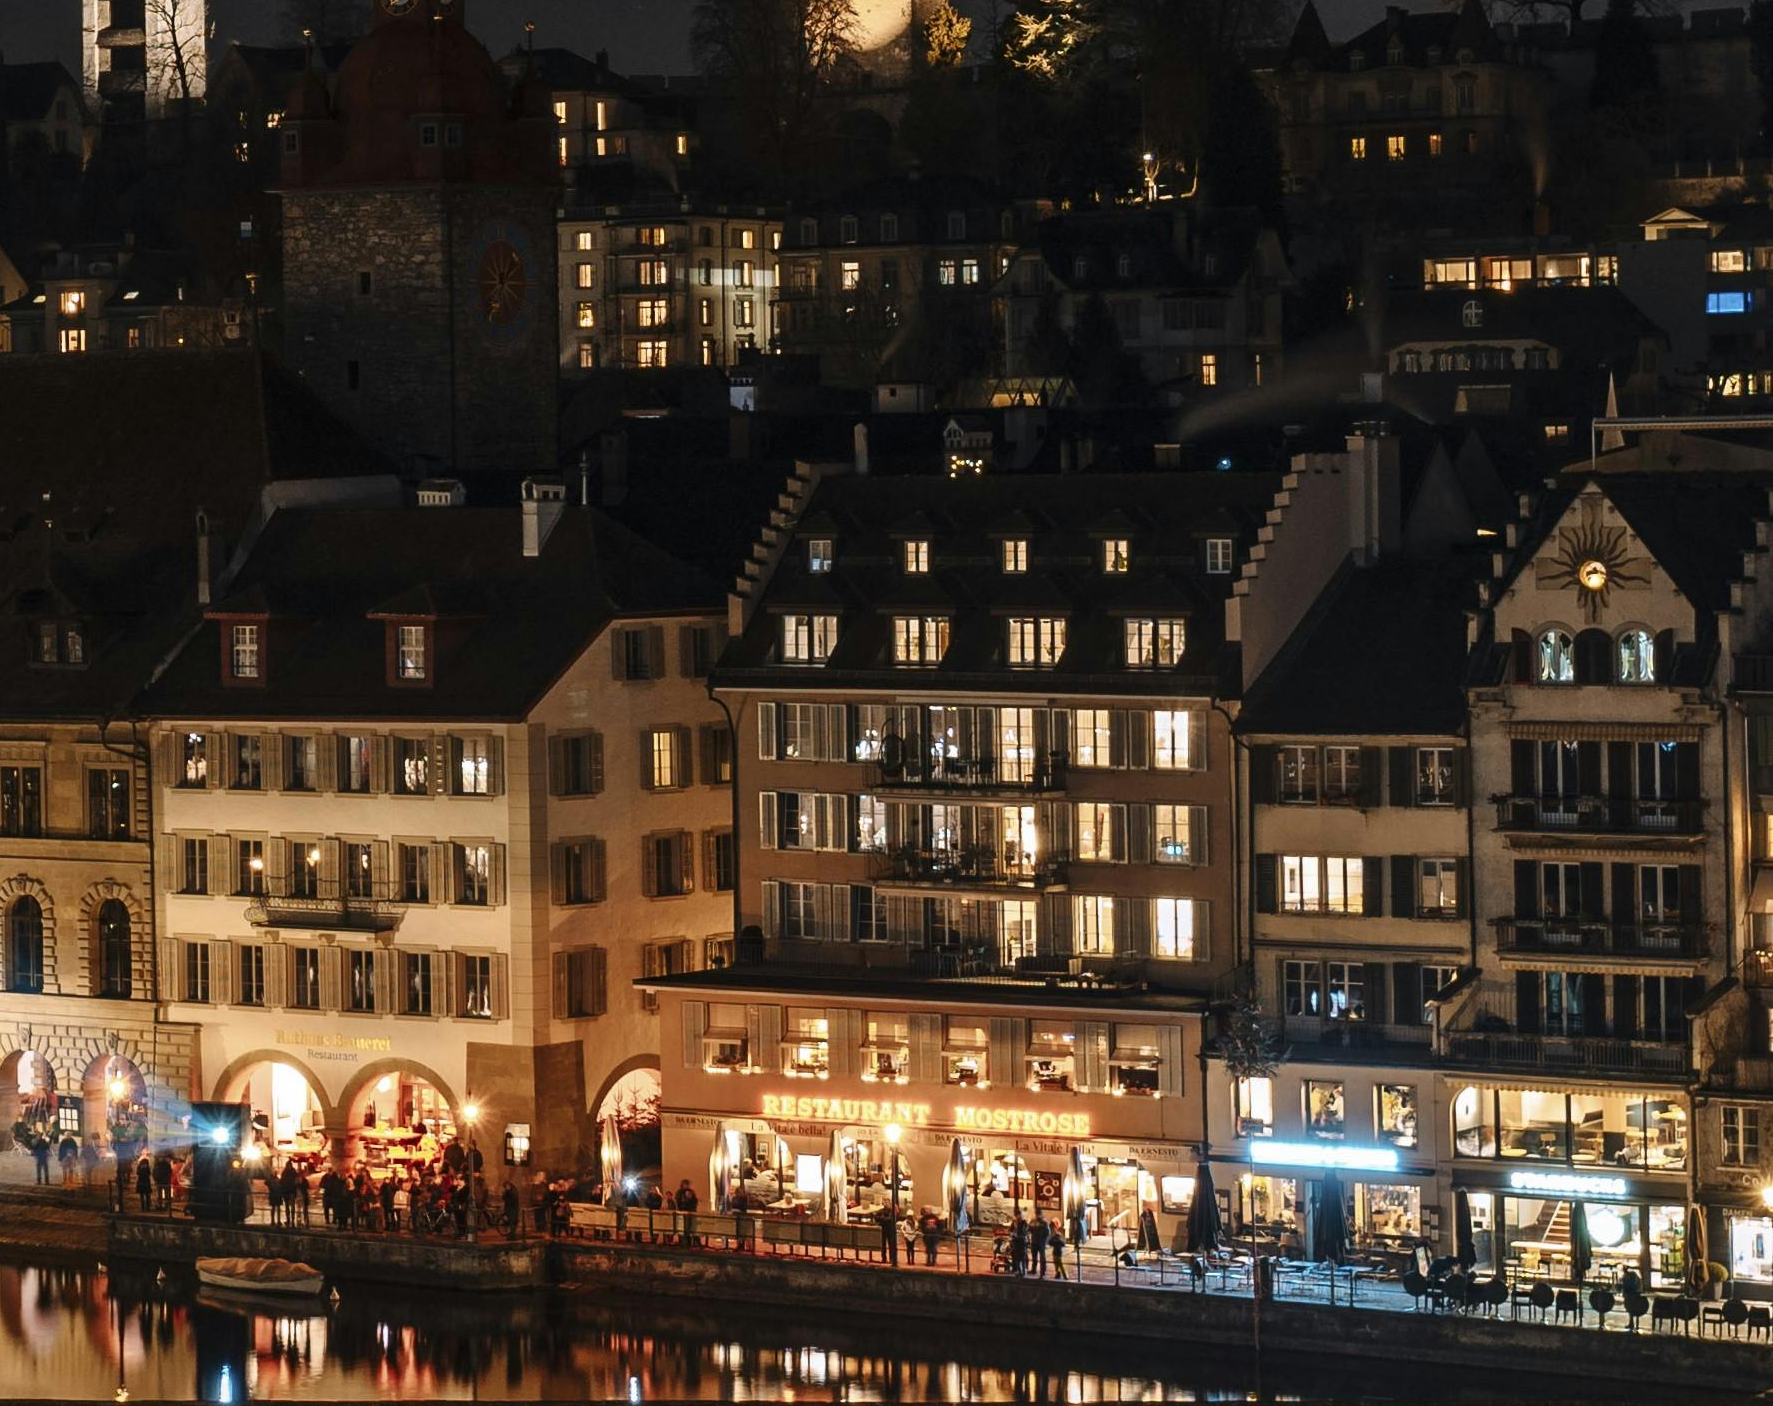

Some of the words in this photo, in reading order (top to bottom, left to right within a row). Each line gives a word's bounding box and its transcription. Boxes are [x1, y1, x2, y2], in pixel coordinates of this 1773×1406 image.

[307, 1048, 359, 1062] Restaurant
[762, 1093, 931, 1124] RESTAURANT
[954, 1105, 1091, 1135] MOSTROSE
[798, 1123, 827, 1137] bella!
[1016, 1139, 1029, 1151] La
[1032, 1140, 1052, 1153] Vita
